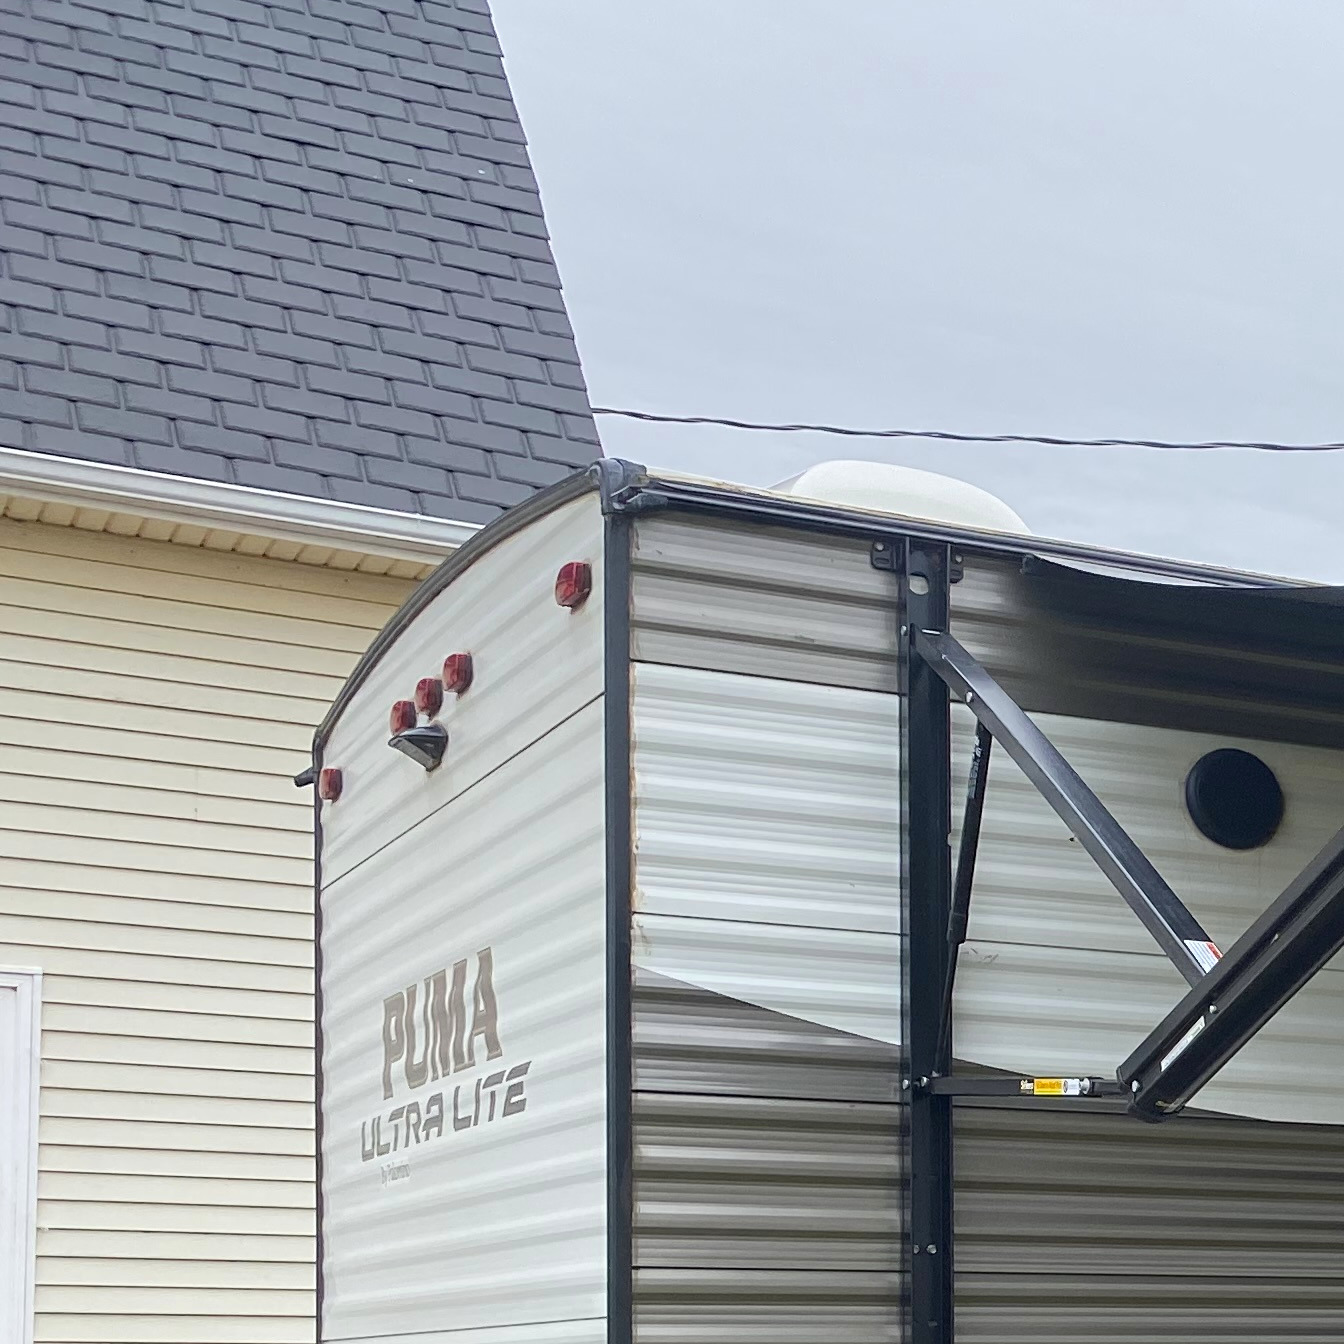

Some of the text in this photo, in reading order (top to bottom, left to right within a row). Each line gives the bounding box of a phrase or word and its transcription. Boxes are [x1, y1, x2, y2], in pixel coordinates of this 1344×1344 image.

[382, 946, 503, 1101] PUMA
[361, 1060, 532, 1162] ULTRA LITE
